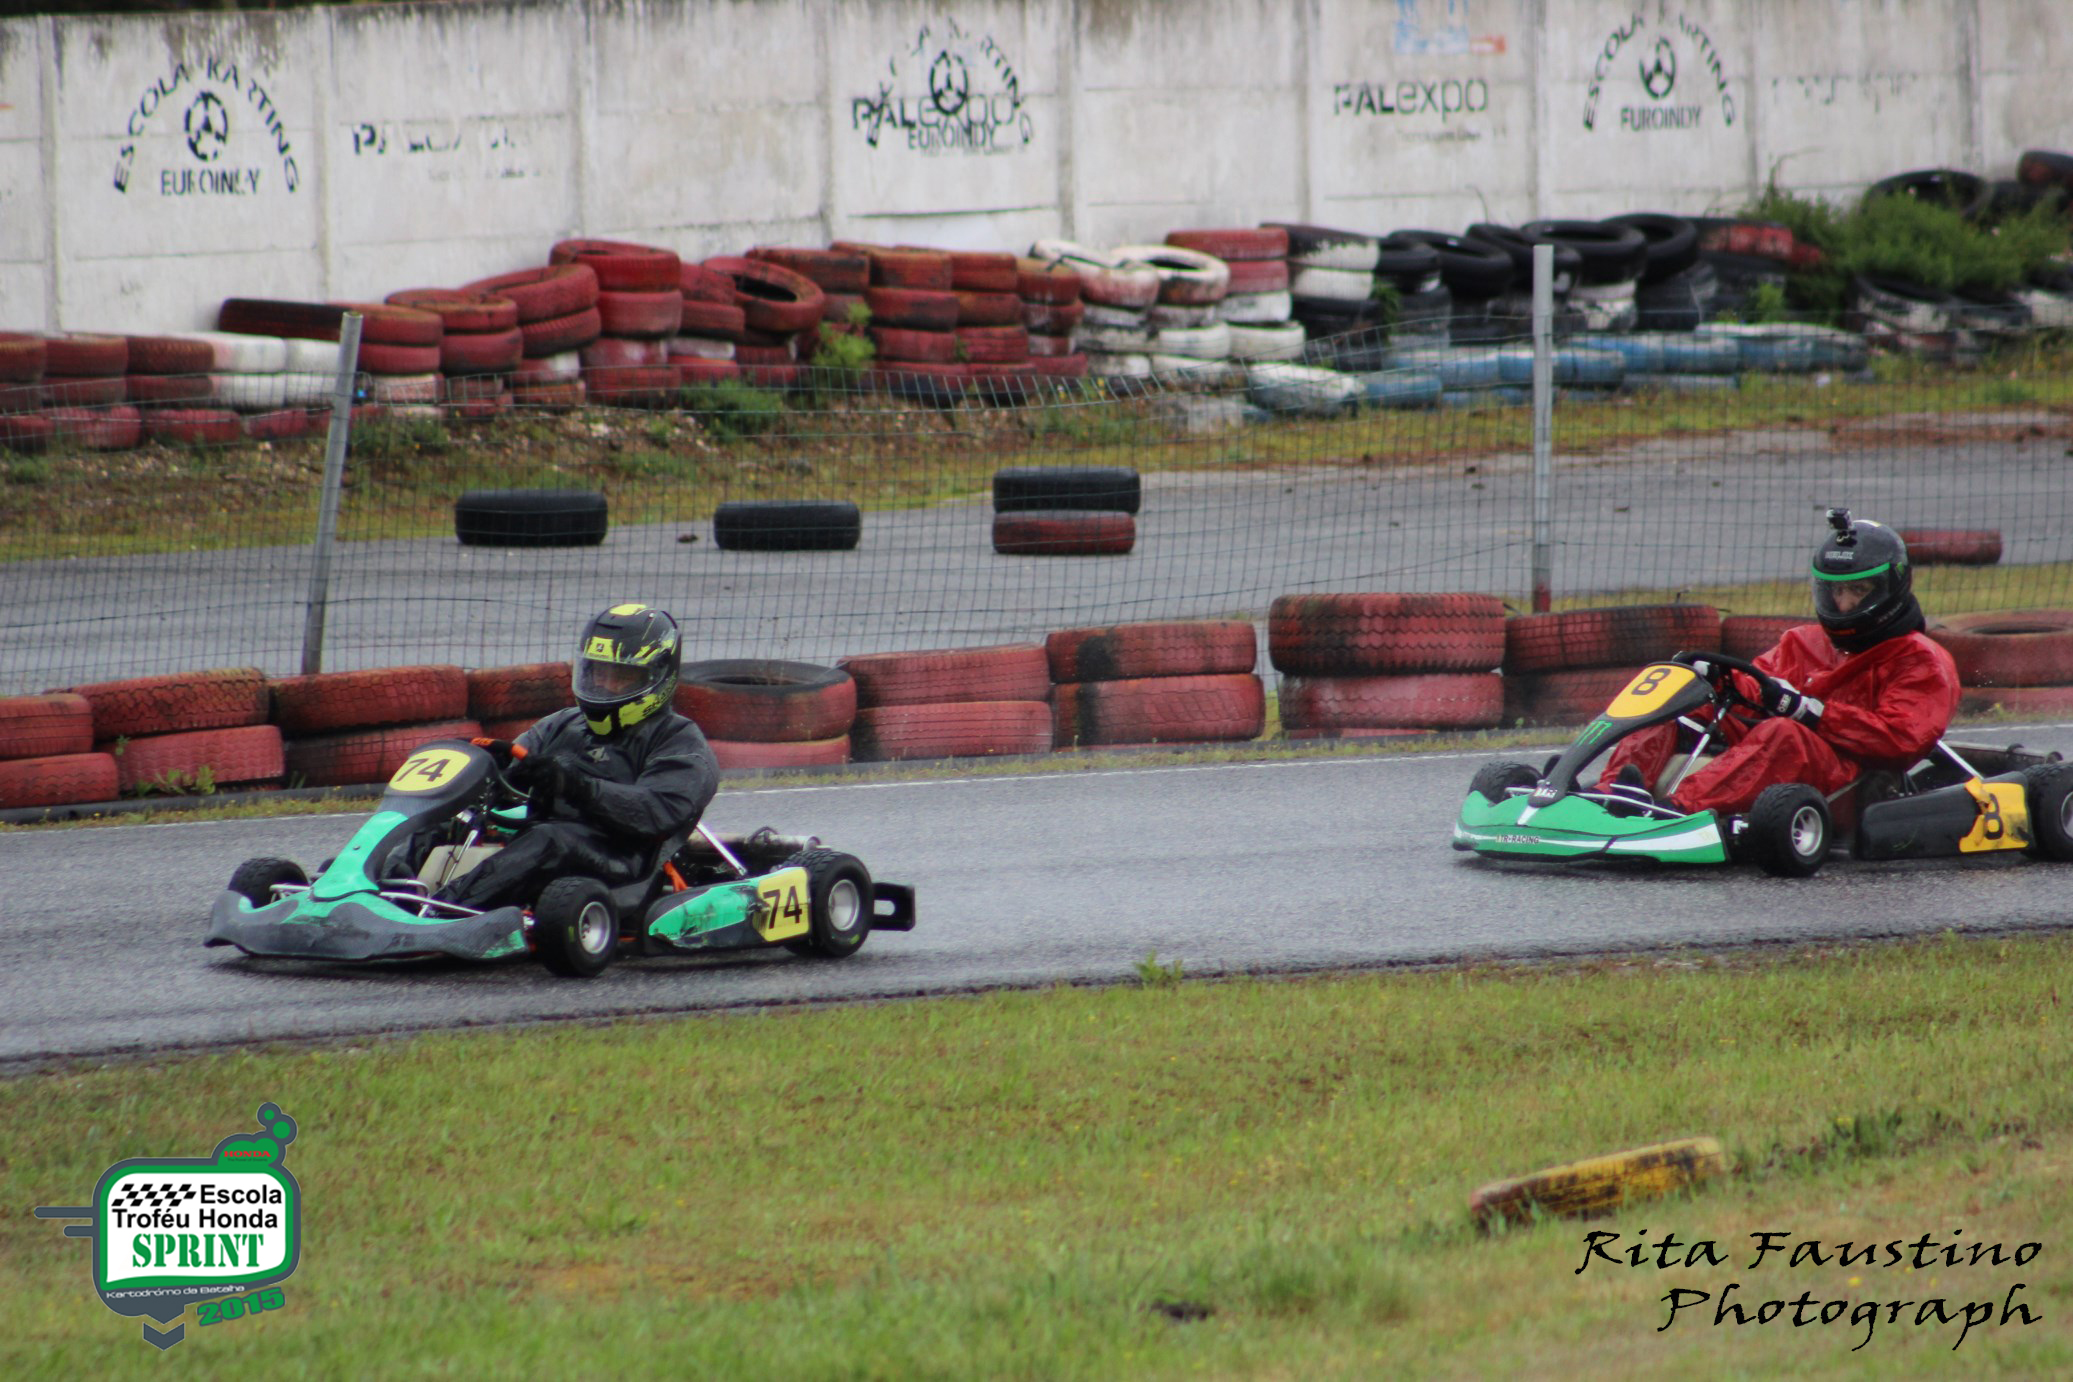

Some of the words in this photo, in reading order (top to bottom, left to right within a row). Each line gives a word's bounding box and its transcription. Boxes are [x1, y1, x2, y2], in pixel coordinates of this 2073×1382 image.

[1631, 667, 1672, 696] 8
[395, 758, 450, 782] 74
[1984, 793, 2004, 840] 8
[763, 885, 803, 930] 74
